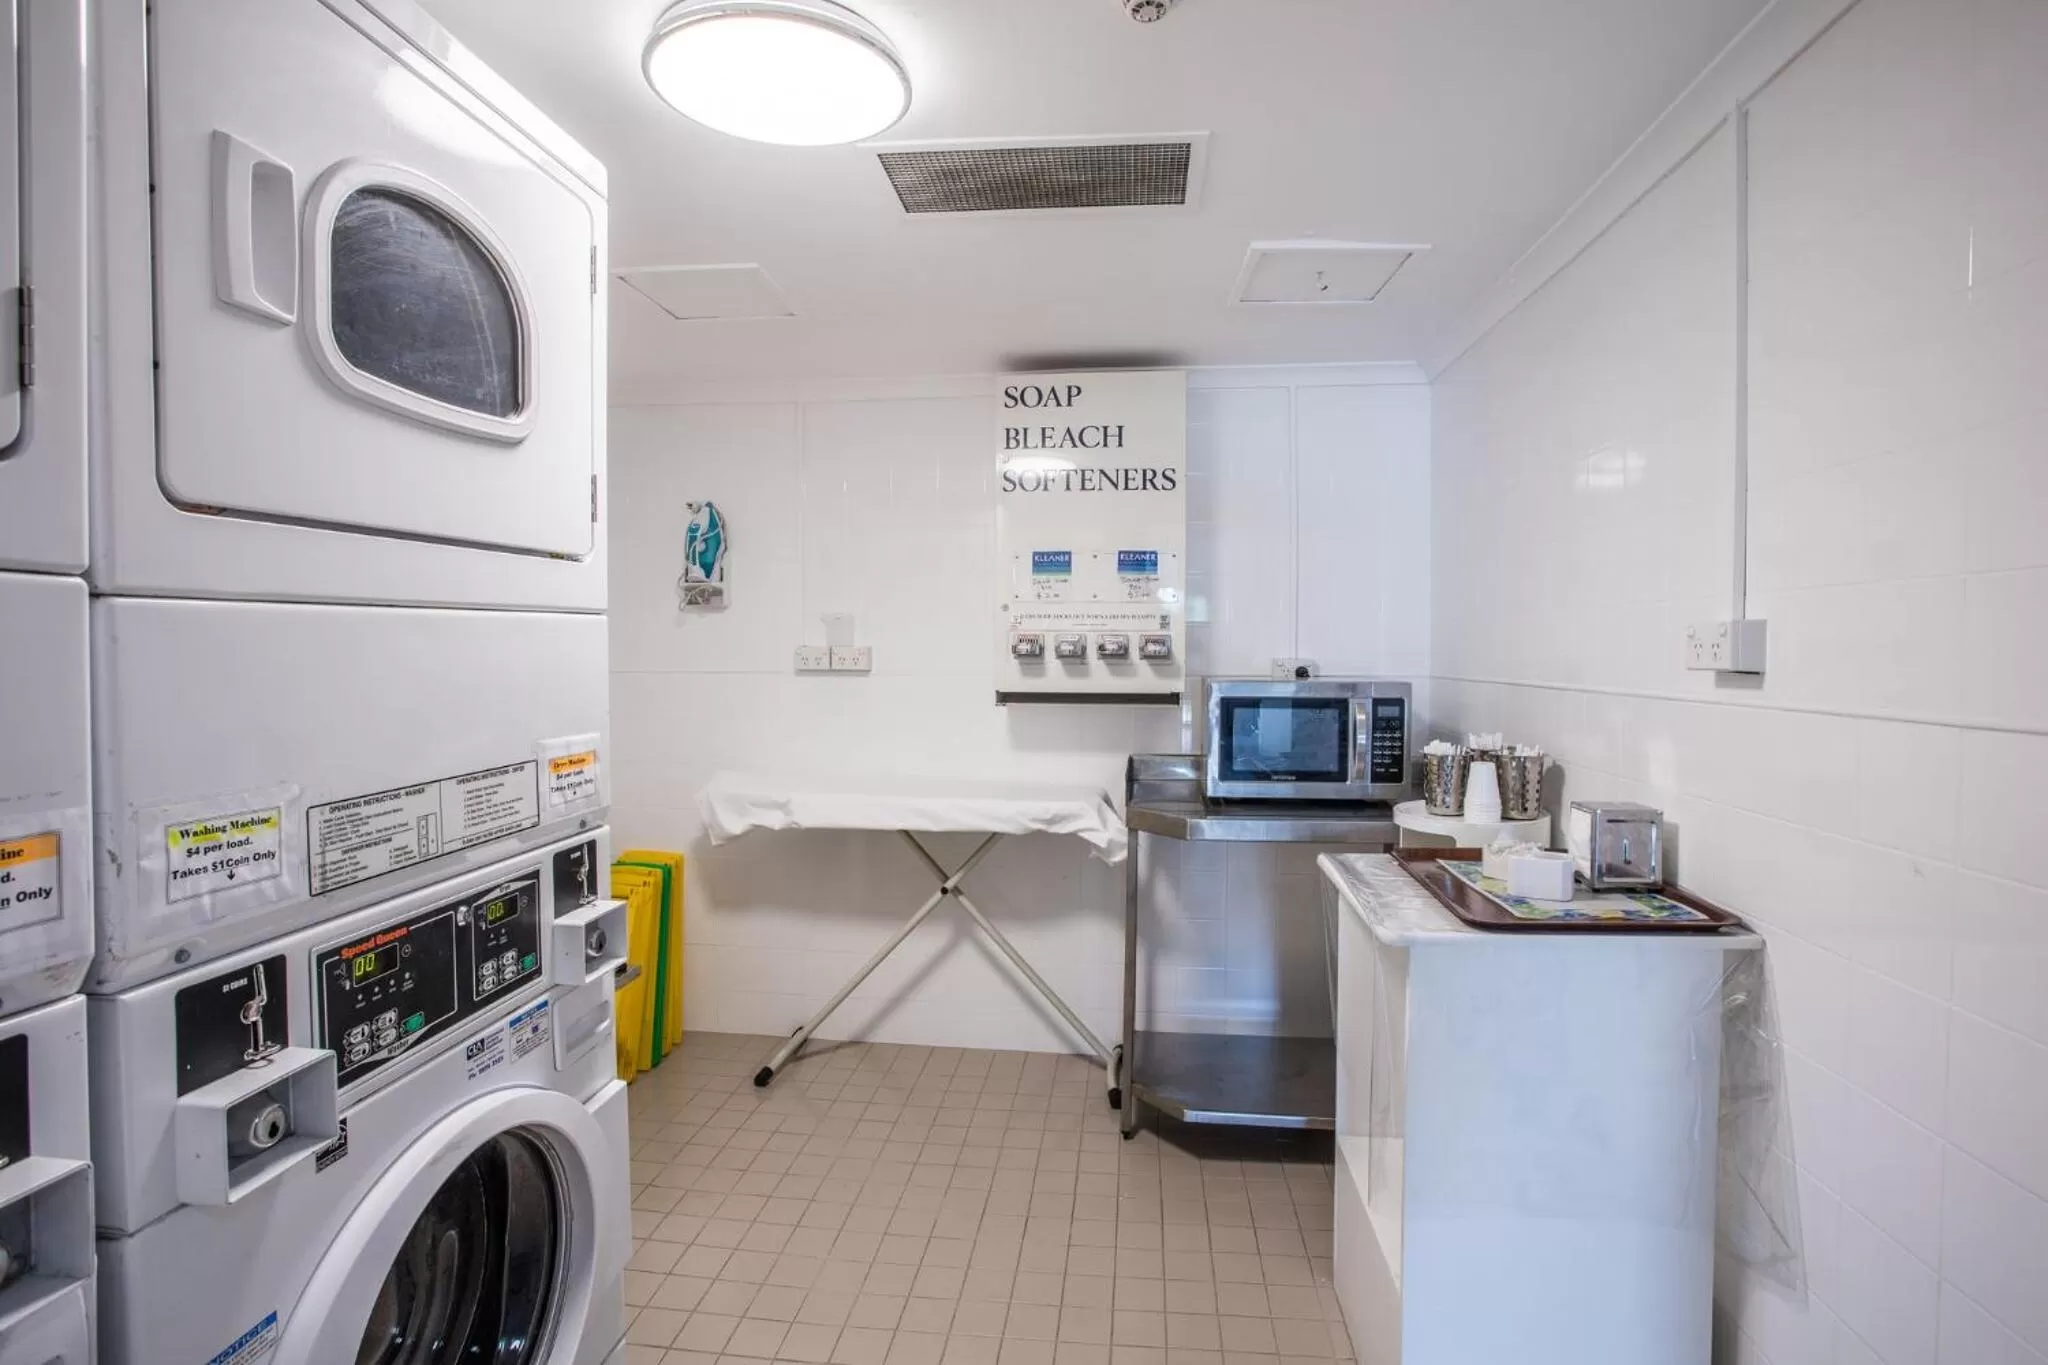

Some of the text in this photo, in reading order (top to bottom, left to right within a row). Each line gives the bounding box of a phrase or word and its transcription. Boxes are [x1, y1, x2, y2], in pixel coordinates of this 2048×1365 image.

[1004, 385, 1082, 409] SOAP
[1004, 425, 1125, 449] BLEACH
[1002, 468, 1177, 493] SOFTENERS
[328, 801, 362, 814] OPERATING
[362, 791, 402, 807] INSTRUCTIONS
[178, 815, 273, 840] Washing Machine
[185, 836, 253, 858] $4 per load.
[171, 865, 209, 880] Takes
[252, 849, 276, 862] Only
[15, 885, 53, 903] Only
[340, 926, 409, 959] Speed Queen
